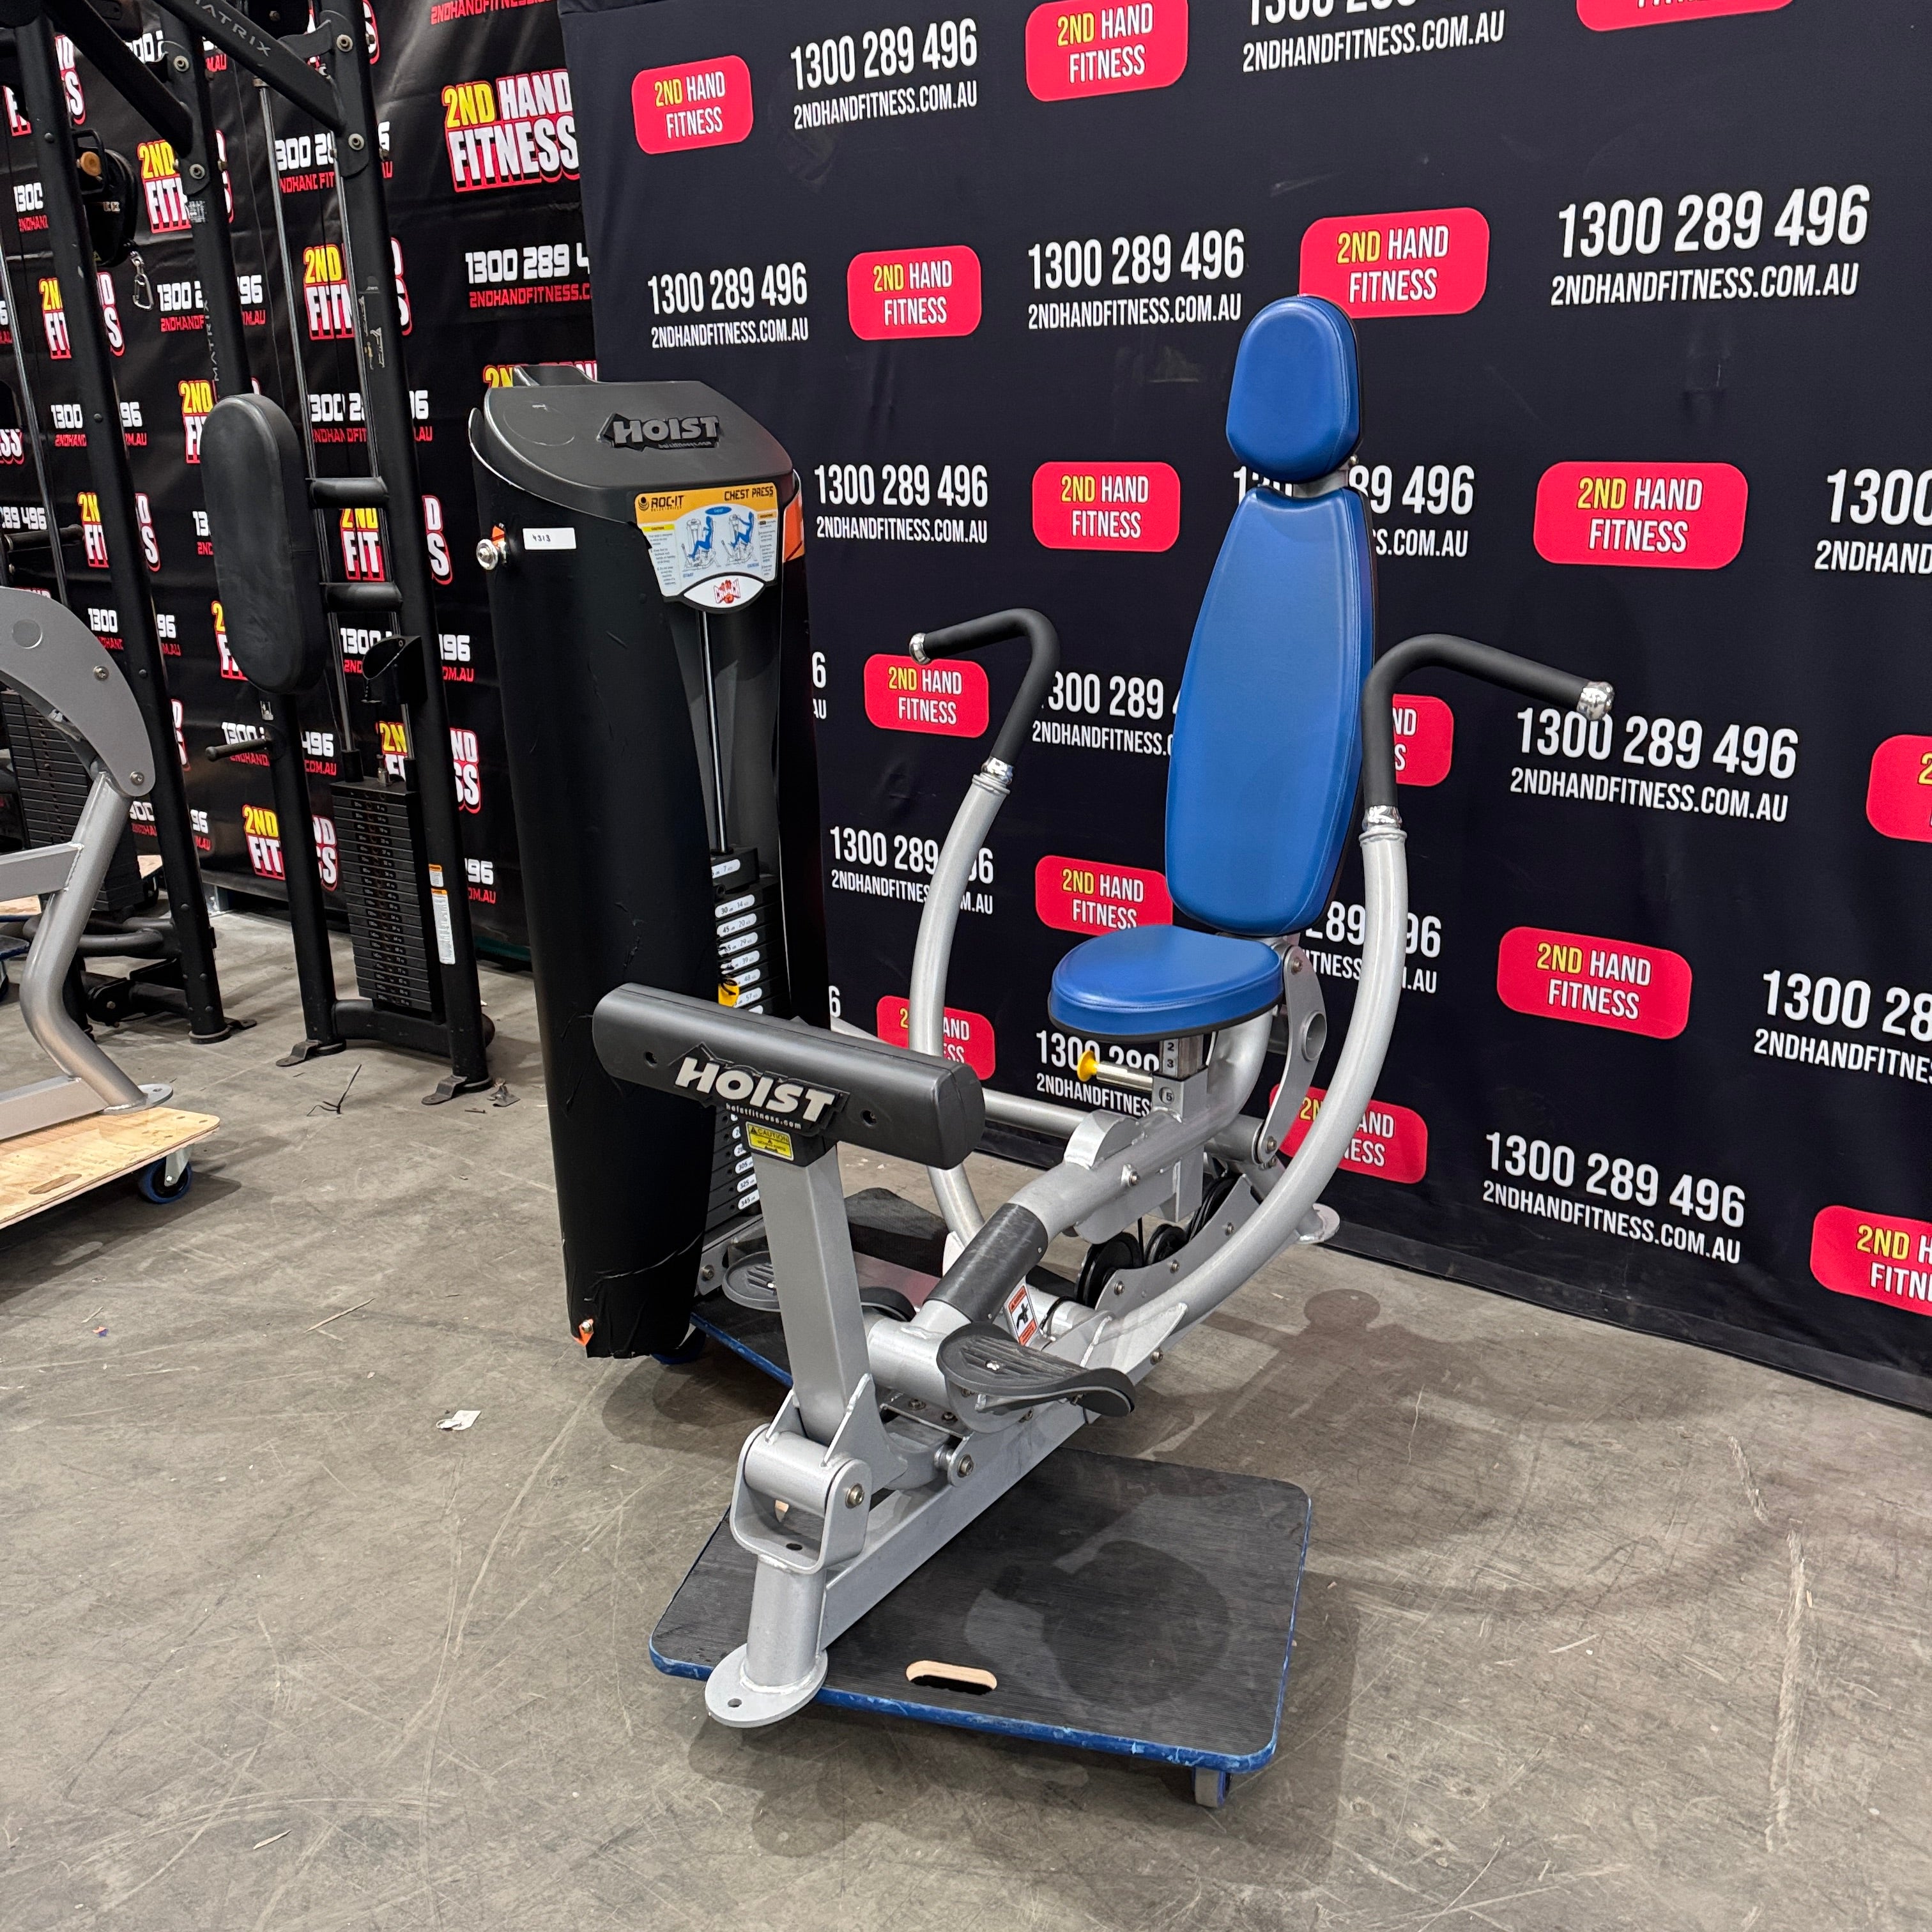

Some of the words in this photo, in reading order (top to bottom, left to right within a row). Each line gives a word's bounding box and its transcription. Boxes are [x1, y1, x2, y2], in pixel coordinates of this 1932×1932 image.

[195, 0, 271, 57] ATRIX
[1057, 12, 1094, 47] 2ND
[1101, 3, 1153, 40] HAND
[1243, 9, 1505, 73] 2NDHANDFITNESS.COM.AU
[790, 35, 855, 91] 1300
[862, 26, 914, 79] 289
[922, 18, 977, 70] 496
[1070, 44, 1146, 84] FITNESS
[443, 83, 496, 128] 2ND
[498, 71, 573, 121] HAND
[654, 79, 683, 107] 2ND
[686, 71, 726, 102] HAND
[793, 80, 977, 130] 2NDHANDFITNESS.COM.AU
[666, 106, 723, 139] FITNESS
[138, 141, 176, 180] 2ND
[275, 135, 312, 171] 300
[447, 114, 579, 182] FITNESS
[1558, 197, 1663, 258] 1300
[1674, 190, 1763, 252] 289
[1774, 184, 1870, 247] 496
[1028, 239, 1102, 289] 1300
[1112, 233, 1171, 285] 289
[1180, 228, 1245, 280] 496
[1337, 231, 1381, 264] 2ND
[1388, 226, 1449, 261] HAND
[305, 246, 342, 284] 2ND
[464, 248, 518, 284] 1300
[523, 243, 570, 280] 289
[873, 264, 904, 292] 2ND
[908, 260, 953, 289] HAND
[157, 281, 192, 312] 1300
[236, 275, 263, 305] 96
[469, 282, 591, 308] 2NDHANDFITNESS.C
[647, 271, 704, 315] 1300
[709, 266, 755, 310] 289
[761, 261, 808, 307] 496
[1349, 268, 1438, 303] FITNESS
[1551, 263, 1859, 306] 2NDHANDFITNESS.COM.AU
[884, 296, 947, 326] FITNESS
[1028, 293, 1241, 330] 2NDHANDFITNESS.COM.AU
[651, 317, 809, 349] 2NDHANDFITNESS.COM.AU
[50, 404, 84, 429] 1300
[119, 401, 143, 427] 96
[180, 381, 213, 415] 2ND
[308, 393, 346, 422] 300
[613, 417, 719, 444] HOIST
[724, 488, 750, 502] CHEST
[751, 486, 774, 498] PRESS
[814, 464, 875, 505] 1300
[882, 464, 930, 506] 289
[937, 464, 988, 507] 496
[1061, 475, 1095, 502] 2ND
[1101, 475, 1149, 503] HAND
[1402, 464, 1475, 515] 496
[1577, 477, 1627, 509] 2ND
[1634, 478, 1703, 511] HAND
[1827, 468, 1932, 526] 1300
[20, 507, 47, 530] 496
[816, 516, 988, 544] 2NDHANDFITNESS.COM.AU
[1072, 510, 1141, 539] FITNESS
[1589, 518, 1688, 553] FITNESS
[88, 608, 119, 633] 1300
[156, 613, 177, 638] 96
[888, 666, 917, 691] 2ND
[922, 669, 962, 695] HAND
[1047, 670, 1100, 714] 300
[1109, 675, 1164, 720] 289
[898, 696, 957, 724] FITNESS
[1032, 719, 1173, 756] 2NDHANDFITNESS.
[1517, 707, 1613, 760] 1300
[1623, 716, 1703, 769] 289
[1712, 724, 1798, 779] 496
[1510, 767, 1788, 822] 2NDHANDFITNESS.COM.AU
[190, 809, 209, 834] 96
[243, 806, 279, 838] 2ND
[830, 826, 887, 867] 1300
[894, 834, 938, 875] 289
[466, 858, 494, 885] 96
[1062, 868, 1094, 894] 2ND
[1100, 874, 1144, 903] HAND
[720, 907, 728, 915] 30
[1073, 899, 1137, 930] FITNESS
[1405, 912, 1442, 958] 96
[1537, 942, 1583, 974] 2ND
[1590, 950, 1651, 986] HAND
[1548, 979, 1639, 1020] FITNESS
[1763, 970, 1871, 1029] 1300
[1882, 987, 1932, 1042] 28
[1167, 1042, 1175, 1052] 2
[1167, 1059, 1174, 1068] 3
[675, 1056, 836, 1123] HOIST
[757, 1128, 789, 1142] CAUTION
[1356, 1110, 1395, 1138] AND
[740, 1179, 749, 1189] 325
[1486, 1131, 1575, 1187] 1300
[1586, 1153, 1659, 1207] 289
[1669, 1174, 1745, 1227] 496
[740, 1197, 751, 1207] 345
[1482, 1180, 1740, 1264] 2NDHANDFITNESS.COM.AU
[1857, 1225, 1910, 1260] 2ND
[1871, 1261, 1932, 1302] FITN
